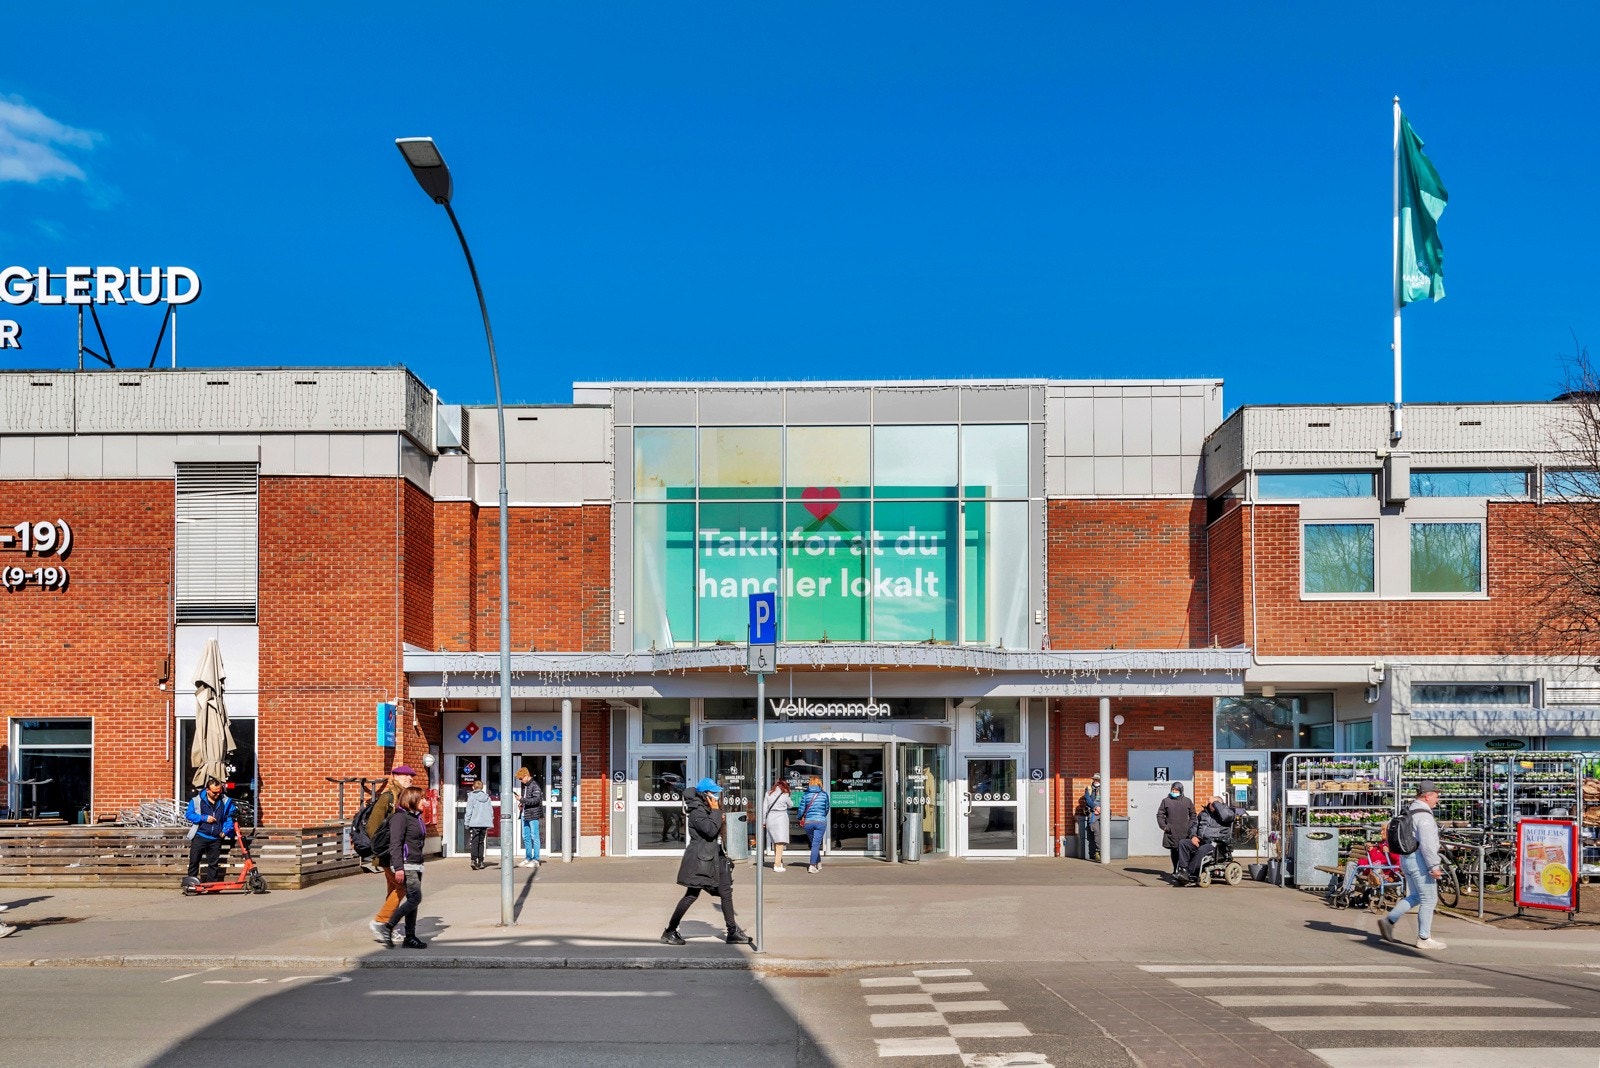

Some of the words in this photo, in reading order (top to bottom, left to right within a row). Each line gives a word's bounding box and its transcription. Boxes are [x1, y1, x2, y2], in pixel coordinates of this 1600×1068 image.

[0, 266, 200, 305] GLERUD
[699, 527, 779, 557] Takk
[788, 526, 841, 556] for
[850, 530, 884, 556] at
[895, 526, 938, 556] du
[2, 566, 67, 588] (9-19)
[699, 568, 832, 598] handler
[841, 568, 939, 597] lokalt
[756, 600, 770, 639] P
[769, 698, 891, 717] Velkommen
